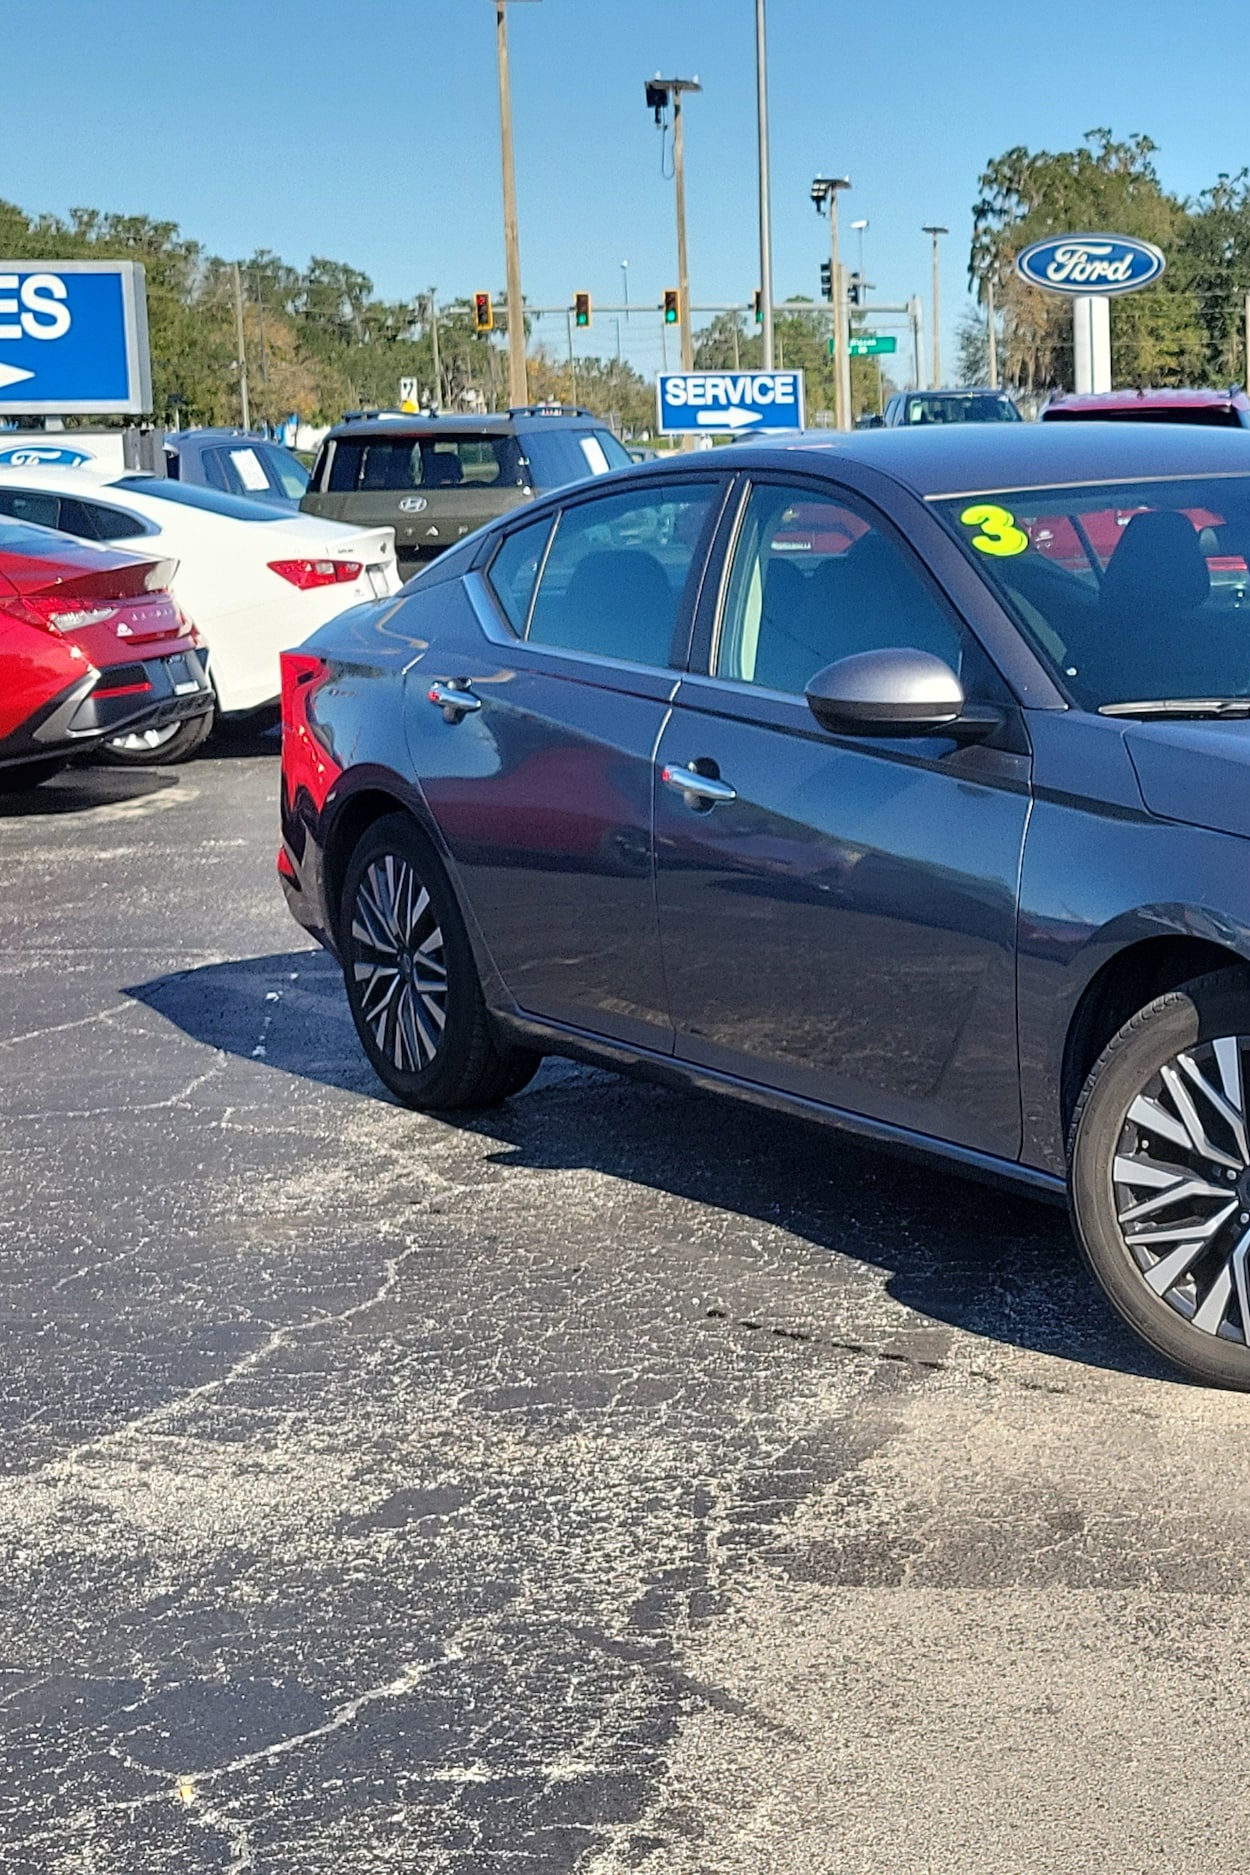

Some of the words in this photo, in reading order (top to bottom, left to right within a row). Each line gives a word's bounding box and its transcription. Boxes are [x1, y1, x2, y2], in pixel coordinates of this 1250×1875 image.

[1046, 244, 1134, 281] Ford
[665, 376, 795, 406] SERVICE
[961, 504, 1028, 556] 3
